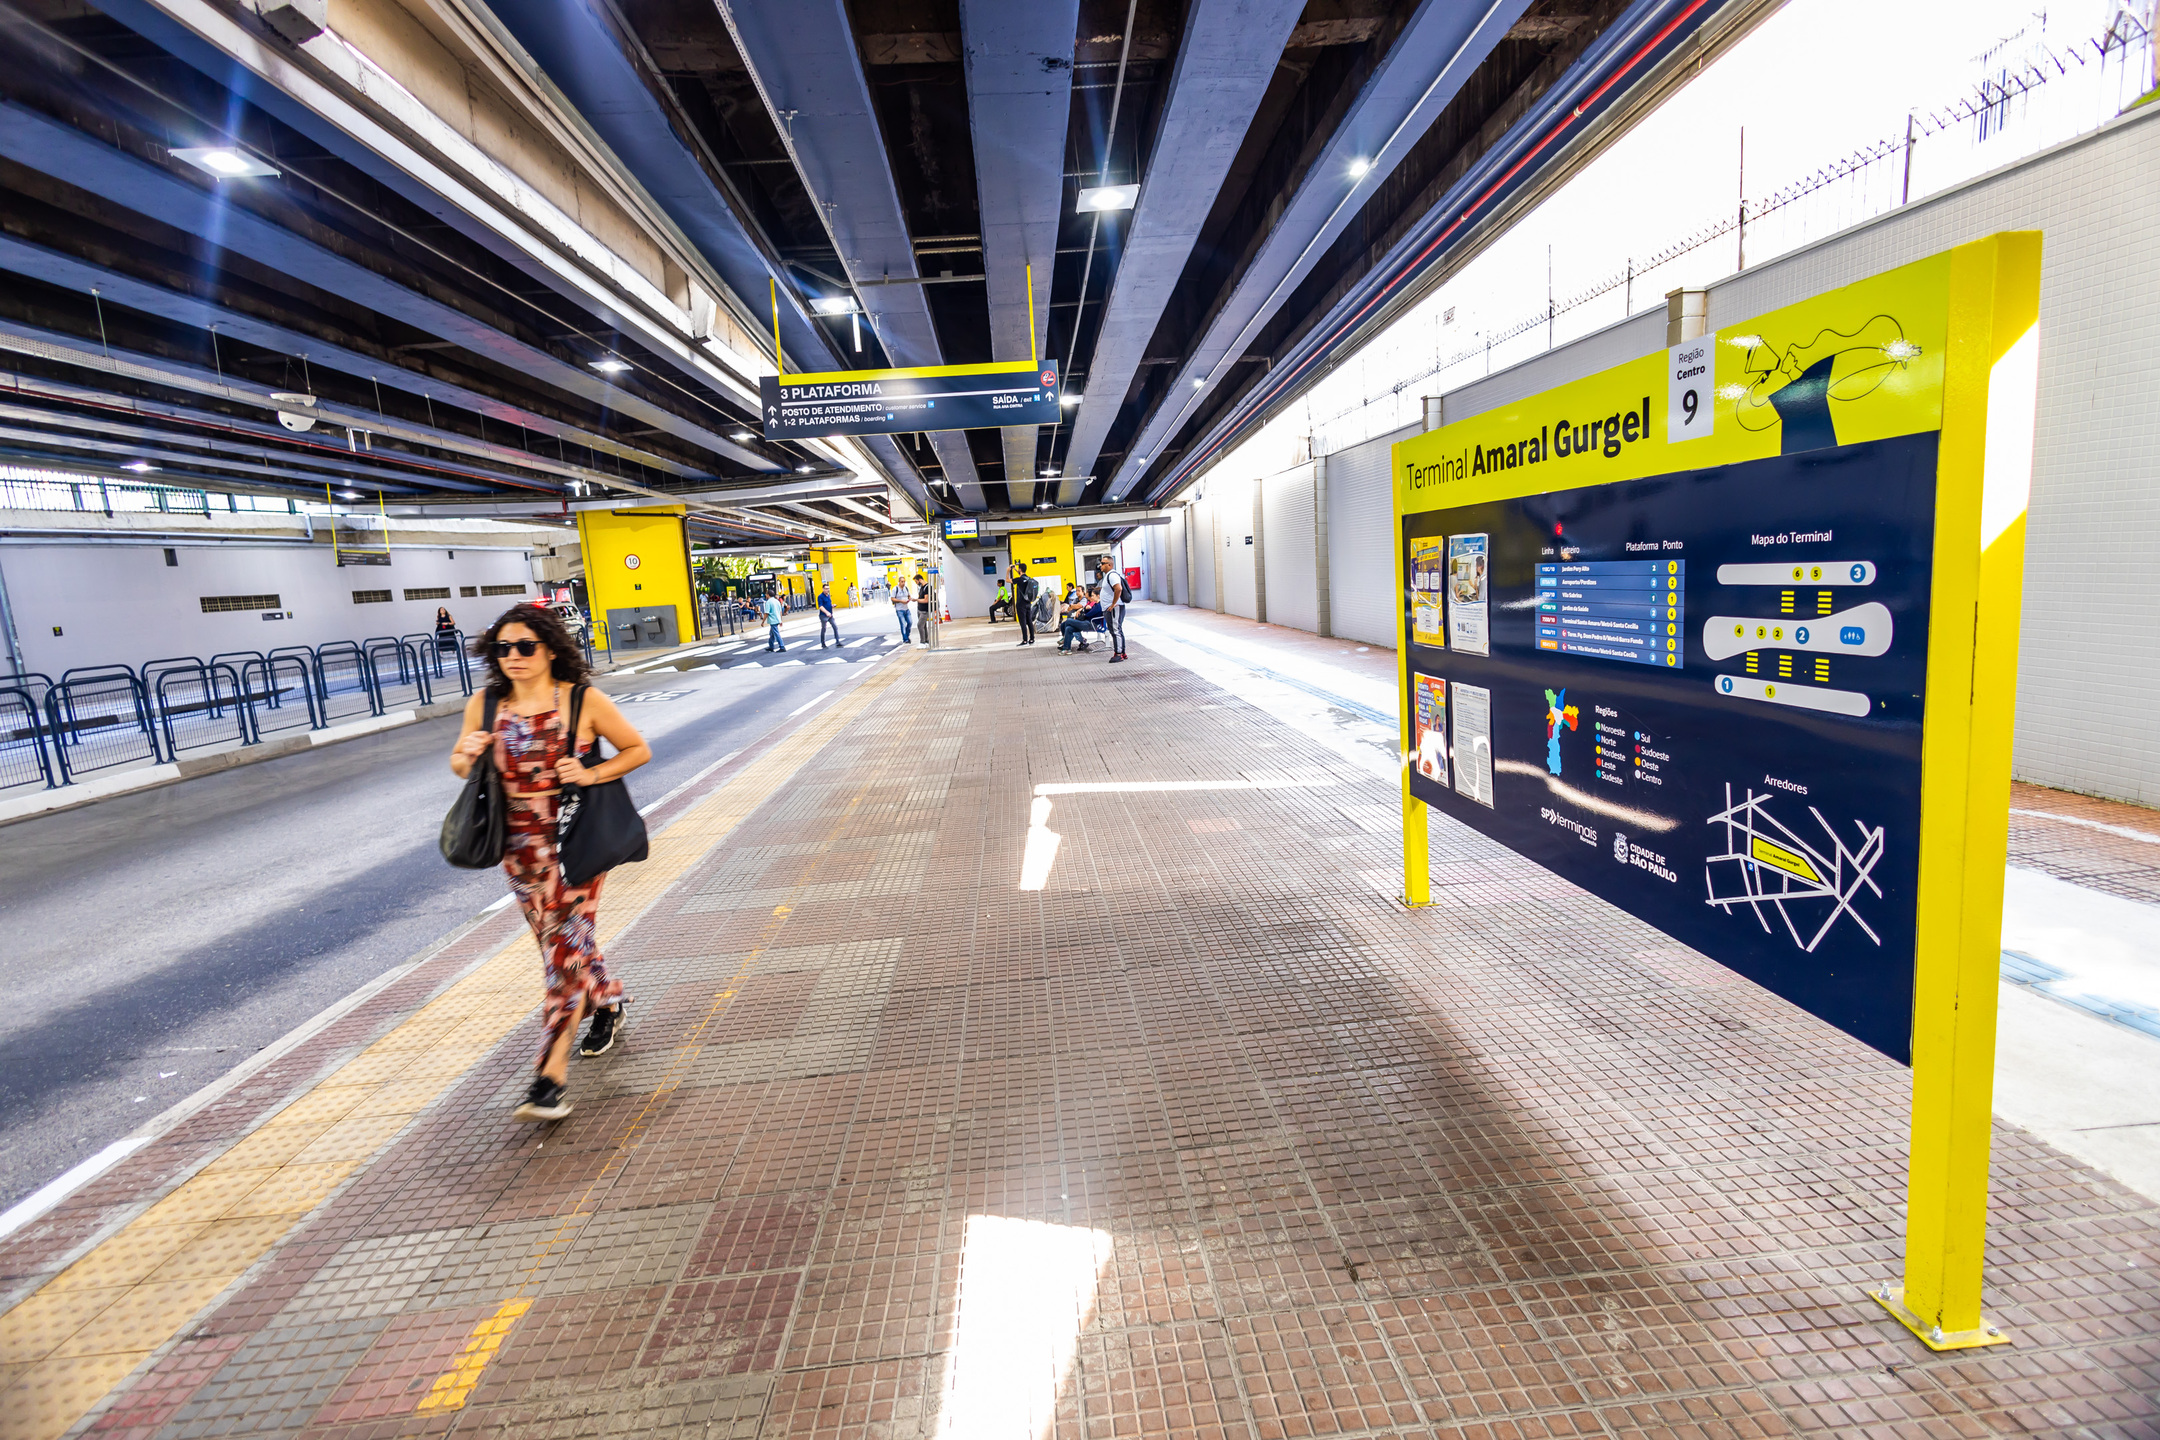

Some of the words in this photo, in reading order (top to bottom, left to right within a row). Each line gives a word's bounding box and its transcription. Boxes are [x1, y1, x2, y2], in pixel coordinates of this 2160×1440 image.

[1678, 347, 1704, 364] Região
[1676, 365, 1706, 380] Centro
[780, 390, 788, 400] 3
[791, 383, 882, 399] PLATAFORMA
[992, 394, 1018, 404] SAÍDA
[782, 407, 810, 417] POSTO
[811, 406, 823, 415] DE
[824, 403, 882, 415] ATENDIMENTO
[1682, 389, 1699, 426] 9
[783, 418, 796, 427] 1-2
[798, 414, 860, 426] PLATAFORMAS
[1407, 448, 1467, 490] Terminal
[1472, 425, 1548, 477] Amaral
[1554, 396, 1650, 458] Gurgel
[1751, 534, 1774, 547] Mapa
[1776, 533, 1788, 544] do
[1789, 530, 1833, 543] Terminal
[1541, 547, 1554, 555] Linha
[1560, 545, 1580, 554] Letreiro
[1626, 541, 1659, 551] Plataforma
[1662, 540, 1684, 550] Ponto
[628, 557, 638, 565] 10
[1795, 570, 1800, 578] 6
[1853, 567, 1862, 578] 3
[1799, 630, 1806, 641] 2
[1724, 680, 1730, 690] 1
[606, 689, 692, 704] ARE
[1595, 705, 1618, 718] Regiões
[1600, 723, 1626, 737] Noroeste
[1600, 736, 1617, 747] Norte
[1641, 733, 1651, 744] Sul
[1601, 748, 1626, 762] Nordeste
[1640, 746, 1670, 762] Sudoeste
[1601, 760, 1616, 771] Leste
[1641, 759, 1659, 772] Oeste
[1601, 771, 1623, 785] Sudeste
[1641, 772, 1662, 785] Centro
[1764, 774, 1808, 795] Arredores
[1630, 843, 1655, 861] CIDADE
[1655, 855, 1666, 866] DE
[1630, 853, 1648, 870] SÃO
[1648, 861, 1678, 883] PAULO
